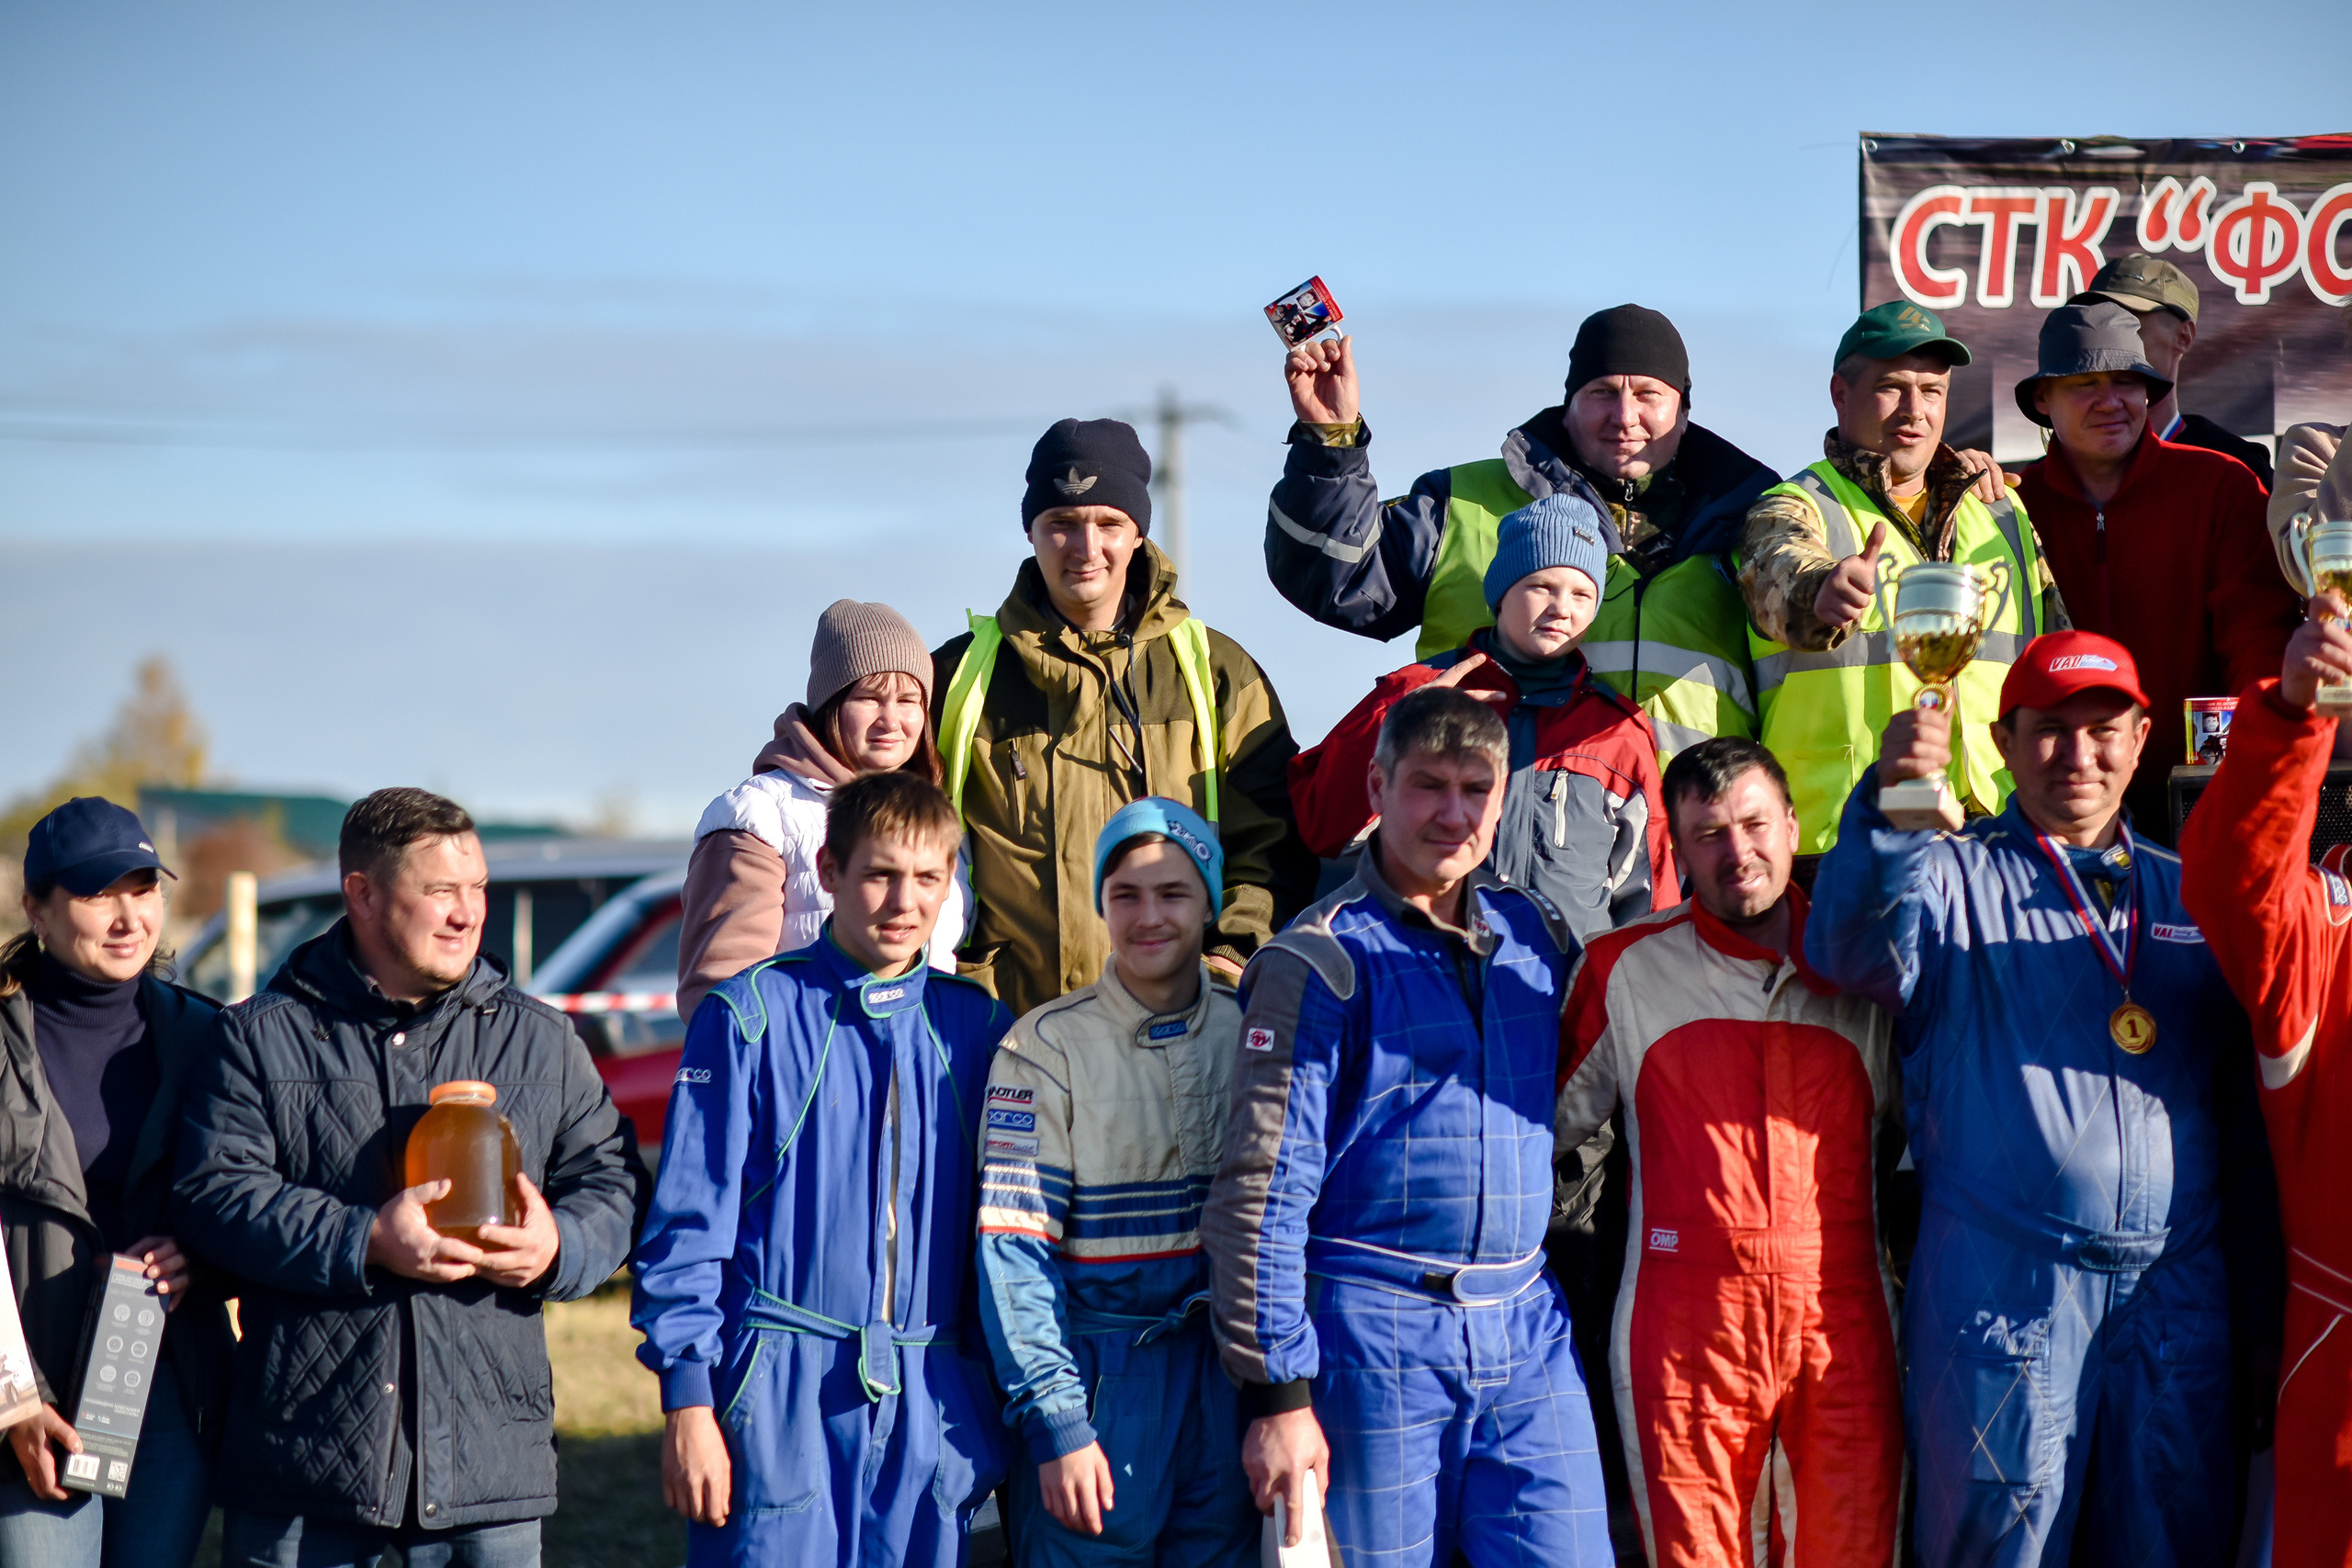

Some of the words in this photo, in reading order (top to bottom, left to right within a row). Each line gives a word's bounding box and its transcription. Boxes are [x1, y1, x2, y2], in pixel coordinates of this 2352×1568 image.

[1890, 185, 2120, 310] СТК
[2127, 1019, 2141, 1039] 1
[1650, 1232, 1679, 1247] OMP
